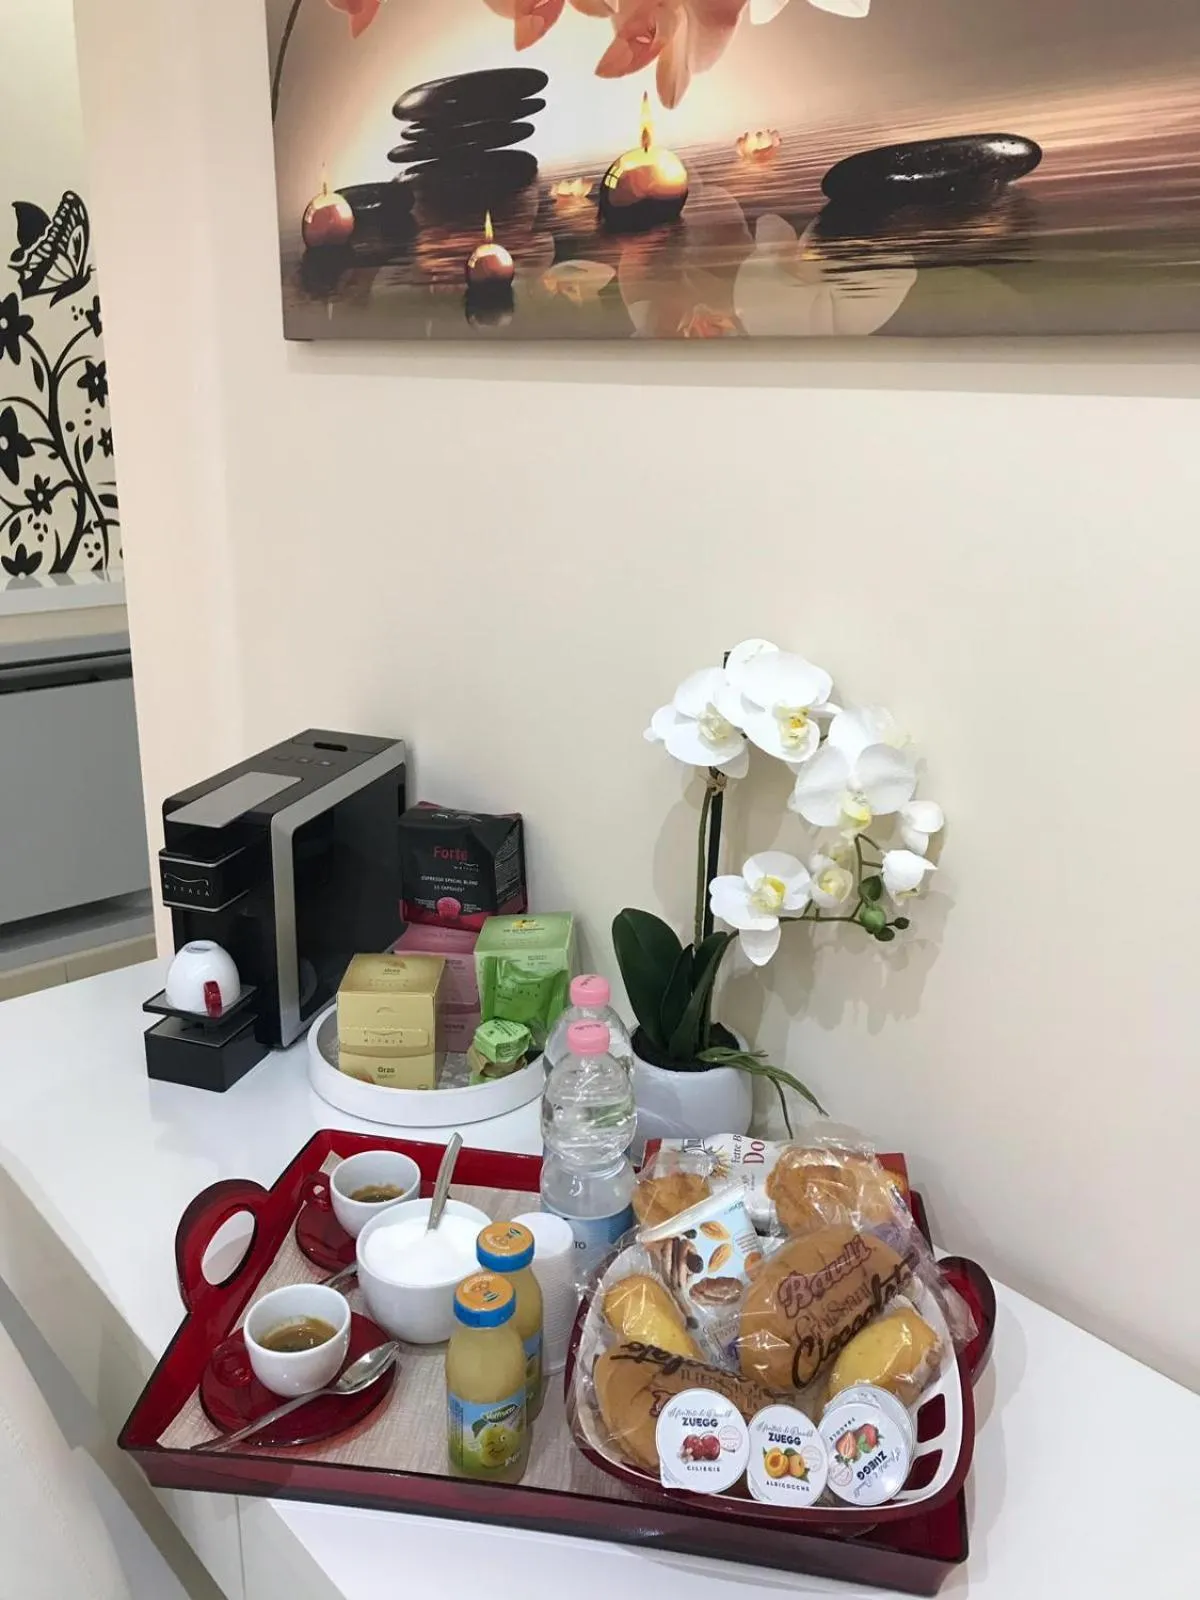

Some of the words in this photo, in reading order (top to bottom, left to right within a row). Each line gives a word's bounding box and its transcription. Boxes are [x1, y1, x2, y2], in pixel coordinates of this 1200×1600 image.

[433, 846, 469, 861] Forte
[682, 1417, 719, 1428] ZUEGG
[768, 1432, 802, 1446] ZUEGG
[686, 1465, 721, 1473] CILIEGIE
[856, 1450, 888, 1480] ZUEGG
[765, 1480, 811, 1492] ALBICOCCHE
